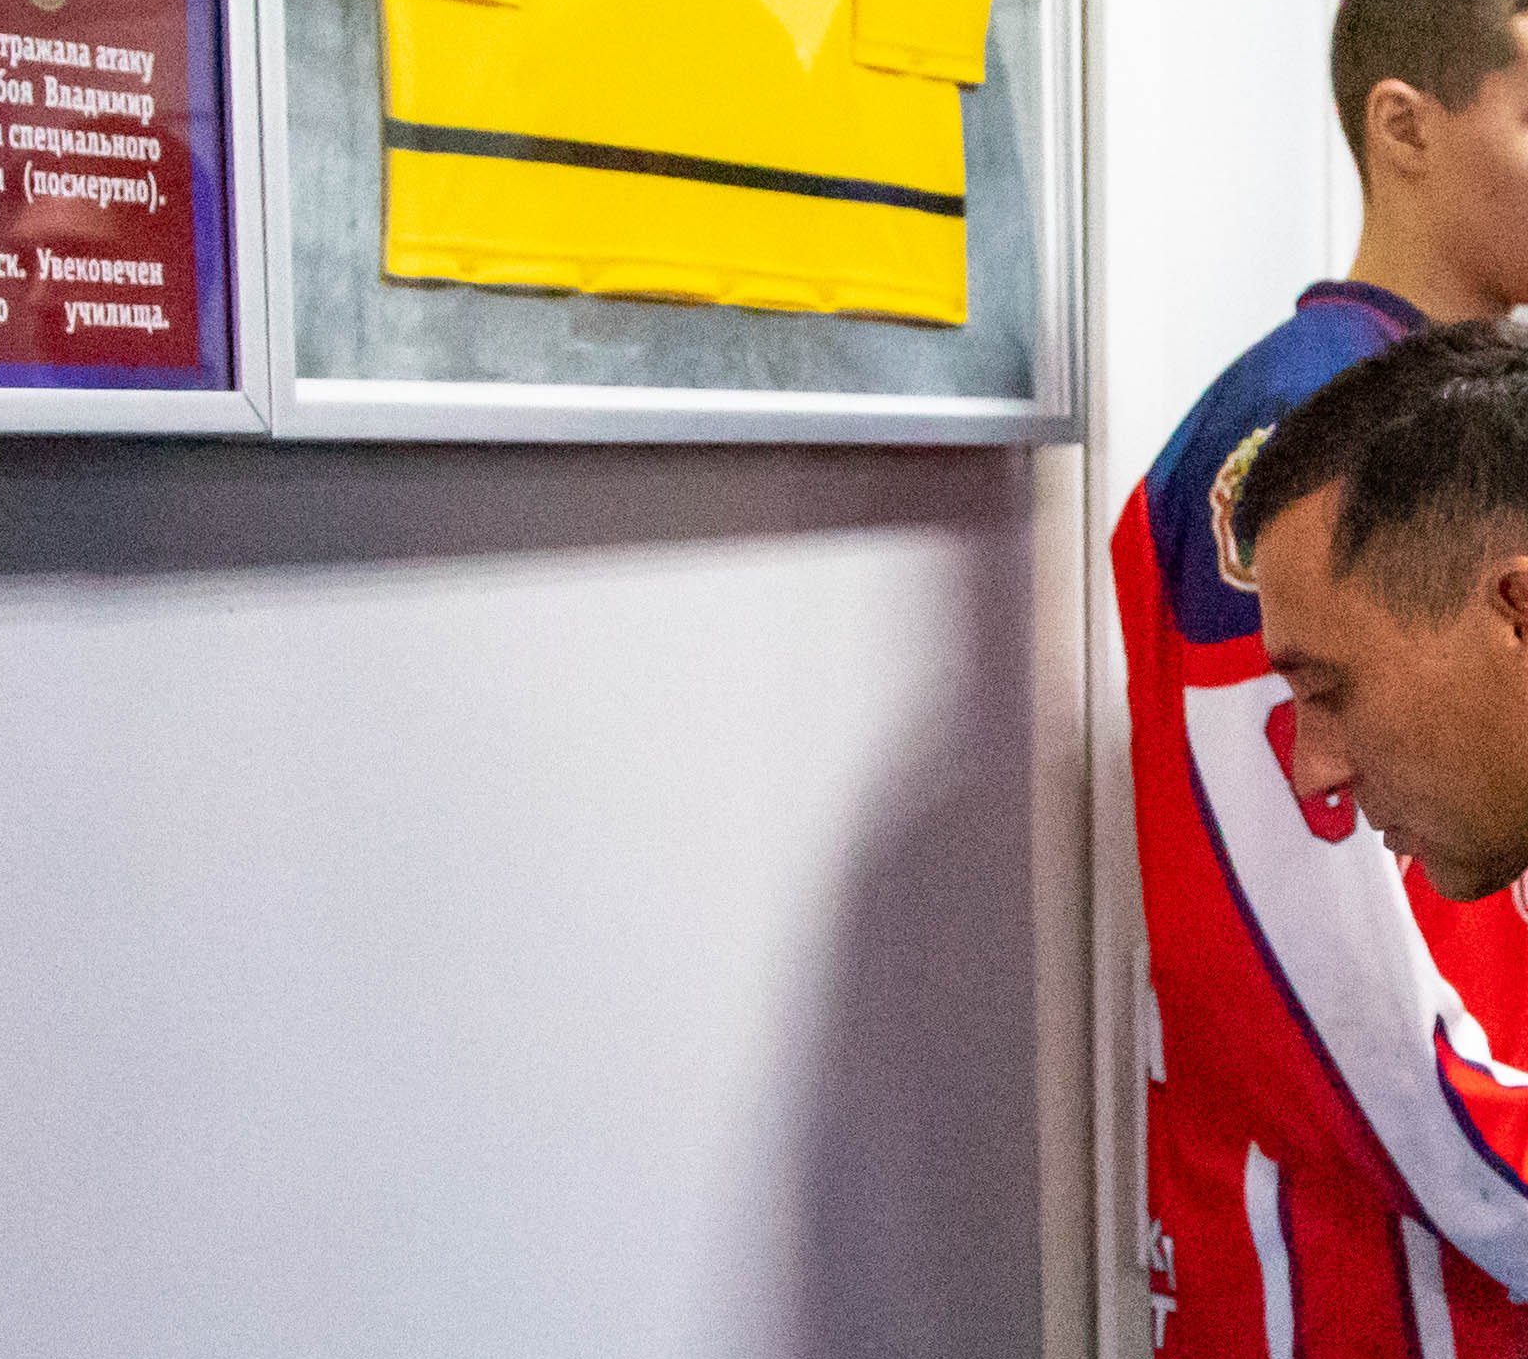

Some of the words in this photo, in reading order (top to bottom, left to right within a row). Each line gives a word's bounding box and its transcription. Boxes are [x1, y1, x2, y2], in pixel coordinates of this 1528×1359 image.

[94, 45, 155, 85] атаку
[44, 75, 155, 126] Владимир
[8, 121, 161, 162] специального
[23, 159, 168, 214] (посмертно).
[36, 247, 165, 286] Увековечен
[64, 300, 171, 335] училища.
